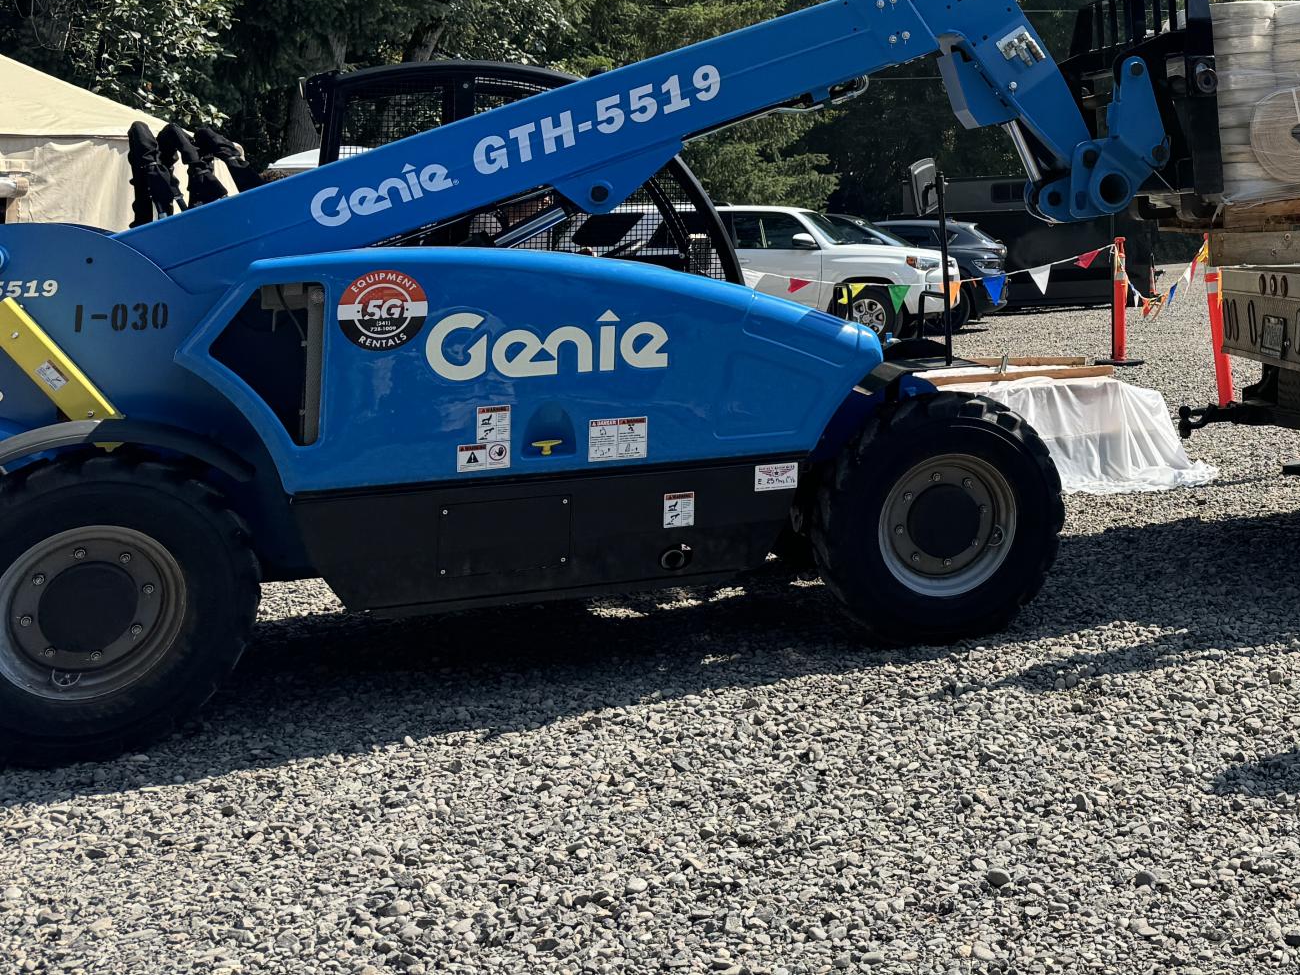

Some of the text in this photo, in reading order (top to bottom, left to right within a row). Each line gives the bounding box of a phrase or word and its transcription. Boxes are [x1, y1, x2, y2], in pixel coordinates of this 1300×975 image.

[310, 65, 720, 226] Genie GTH-5519
[351, 273, 416, 292] EQUIPMENT
[74, 302, 168, 332] I-030
[364, 299, 402, 320] 5G
[359, 333, 406, 347] RENTALS
[425, 309, 669, 381] Genie
